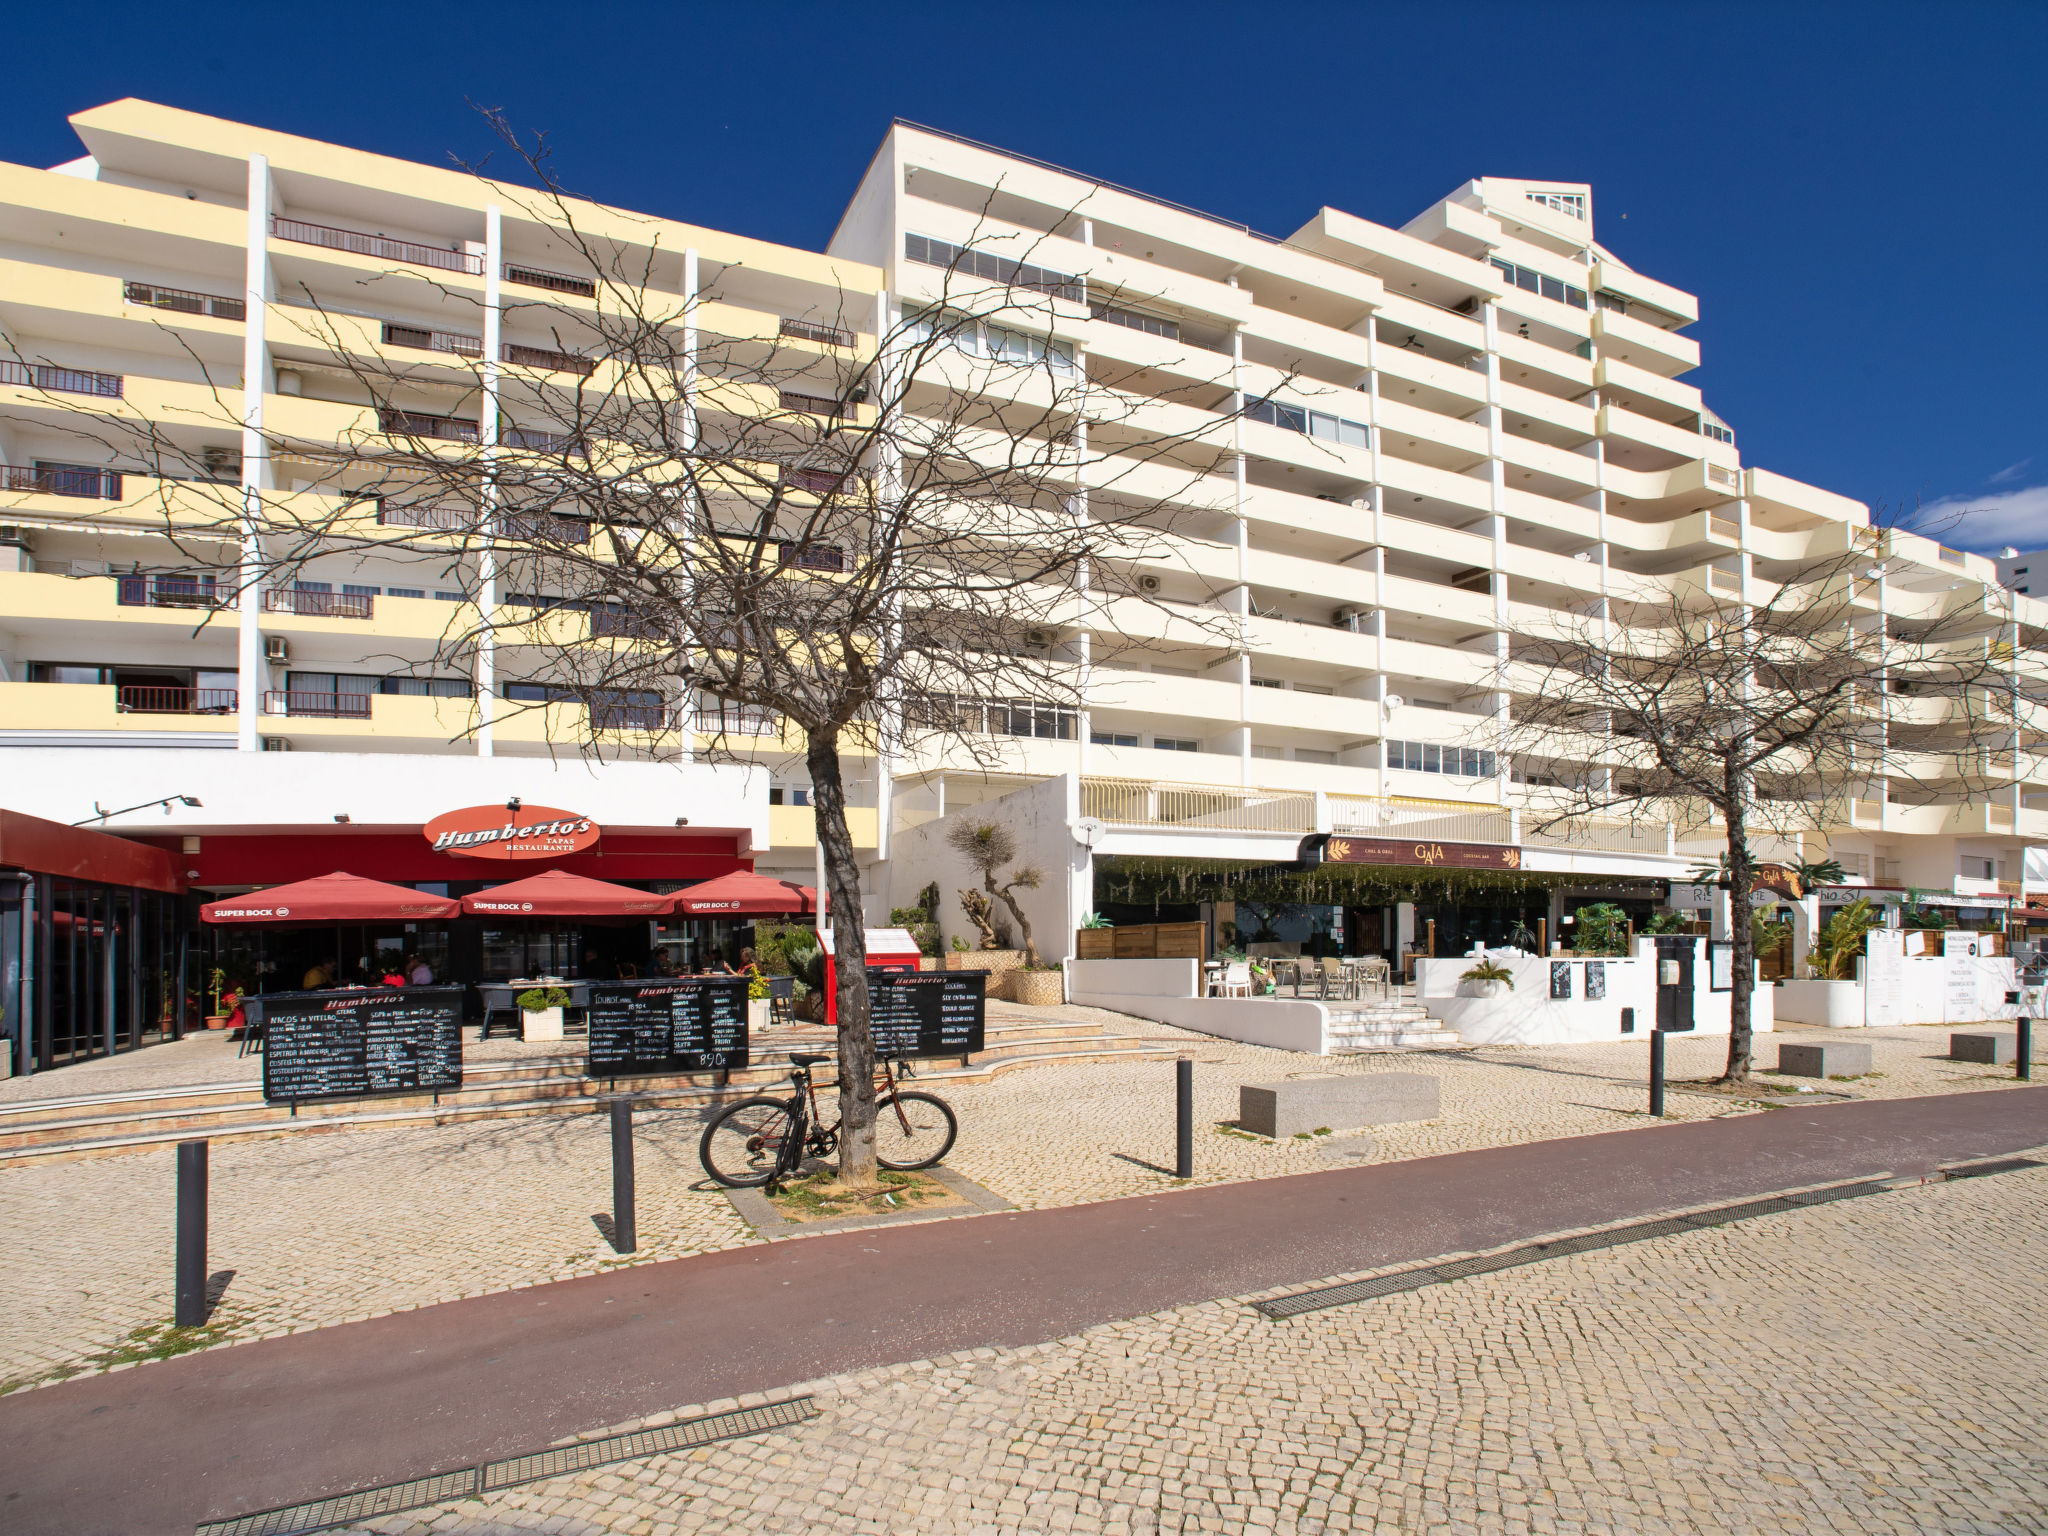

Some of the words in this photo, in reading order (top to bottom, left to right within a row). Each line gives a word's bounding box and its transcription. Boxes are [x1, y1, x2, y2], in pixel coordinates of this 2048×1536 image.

[435, 819, 591, 848] Humberto's
[1414, 844, 1444, 865] GAIA
[473, 902, 497, 910] SUPER
[691, 902, 711, 910] SUPER
[214, 909, 245, 917] SUPER
[246, 909, 273, 917] BOCK
[640, 985, 703, 996] Humberto's
[327, 995, 405, 1009] Humberto's
